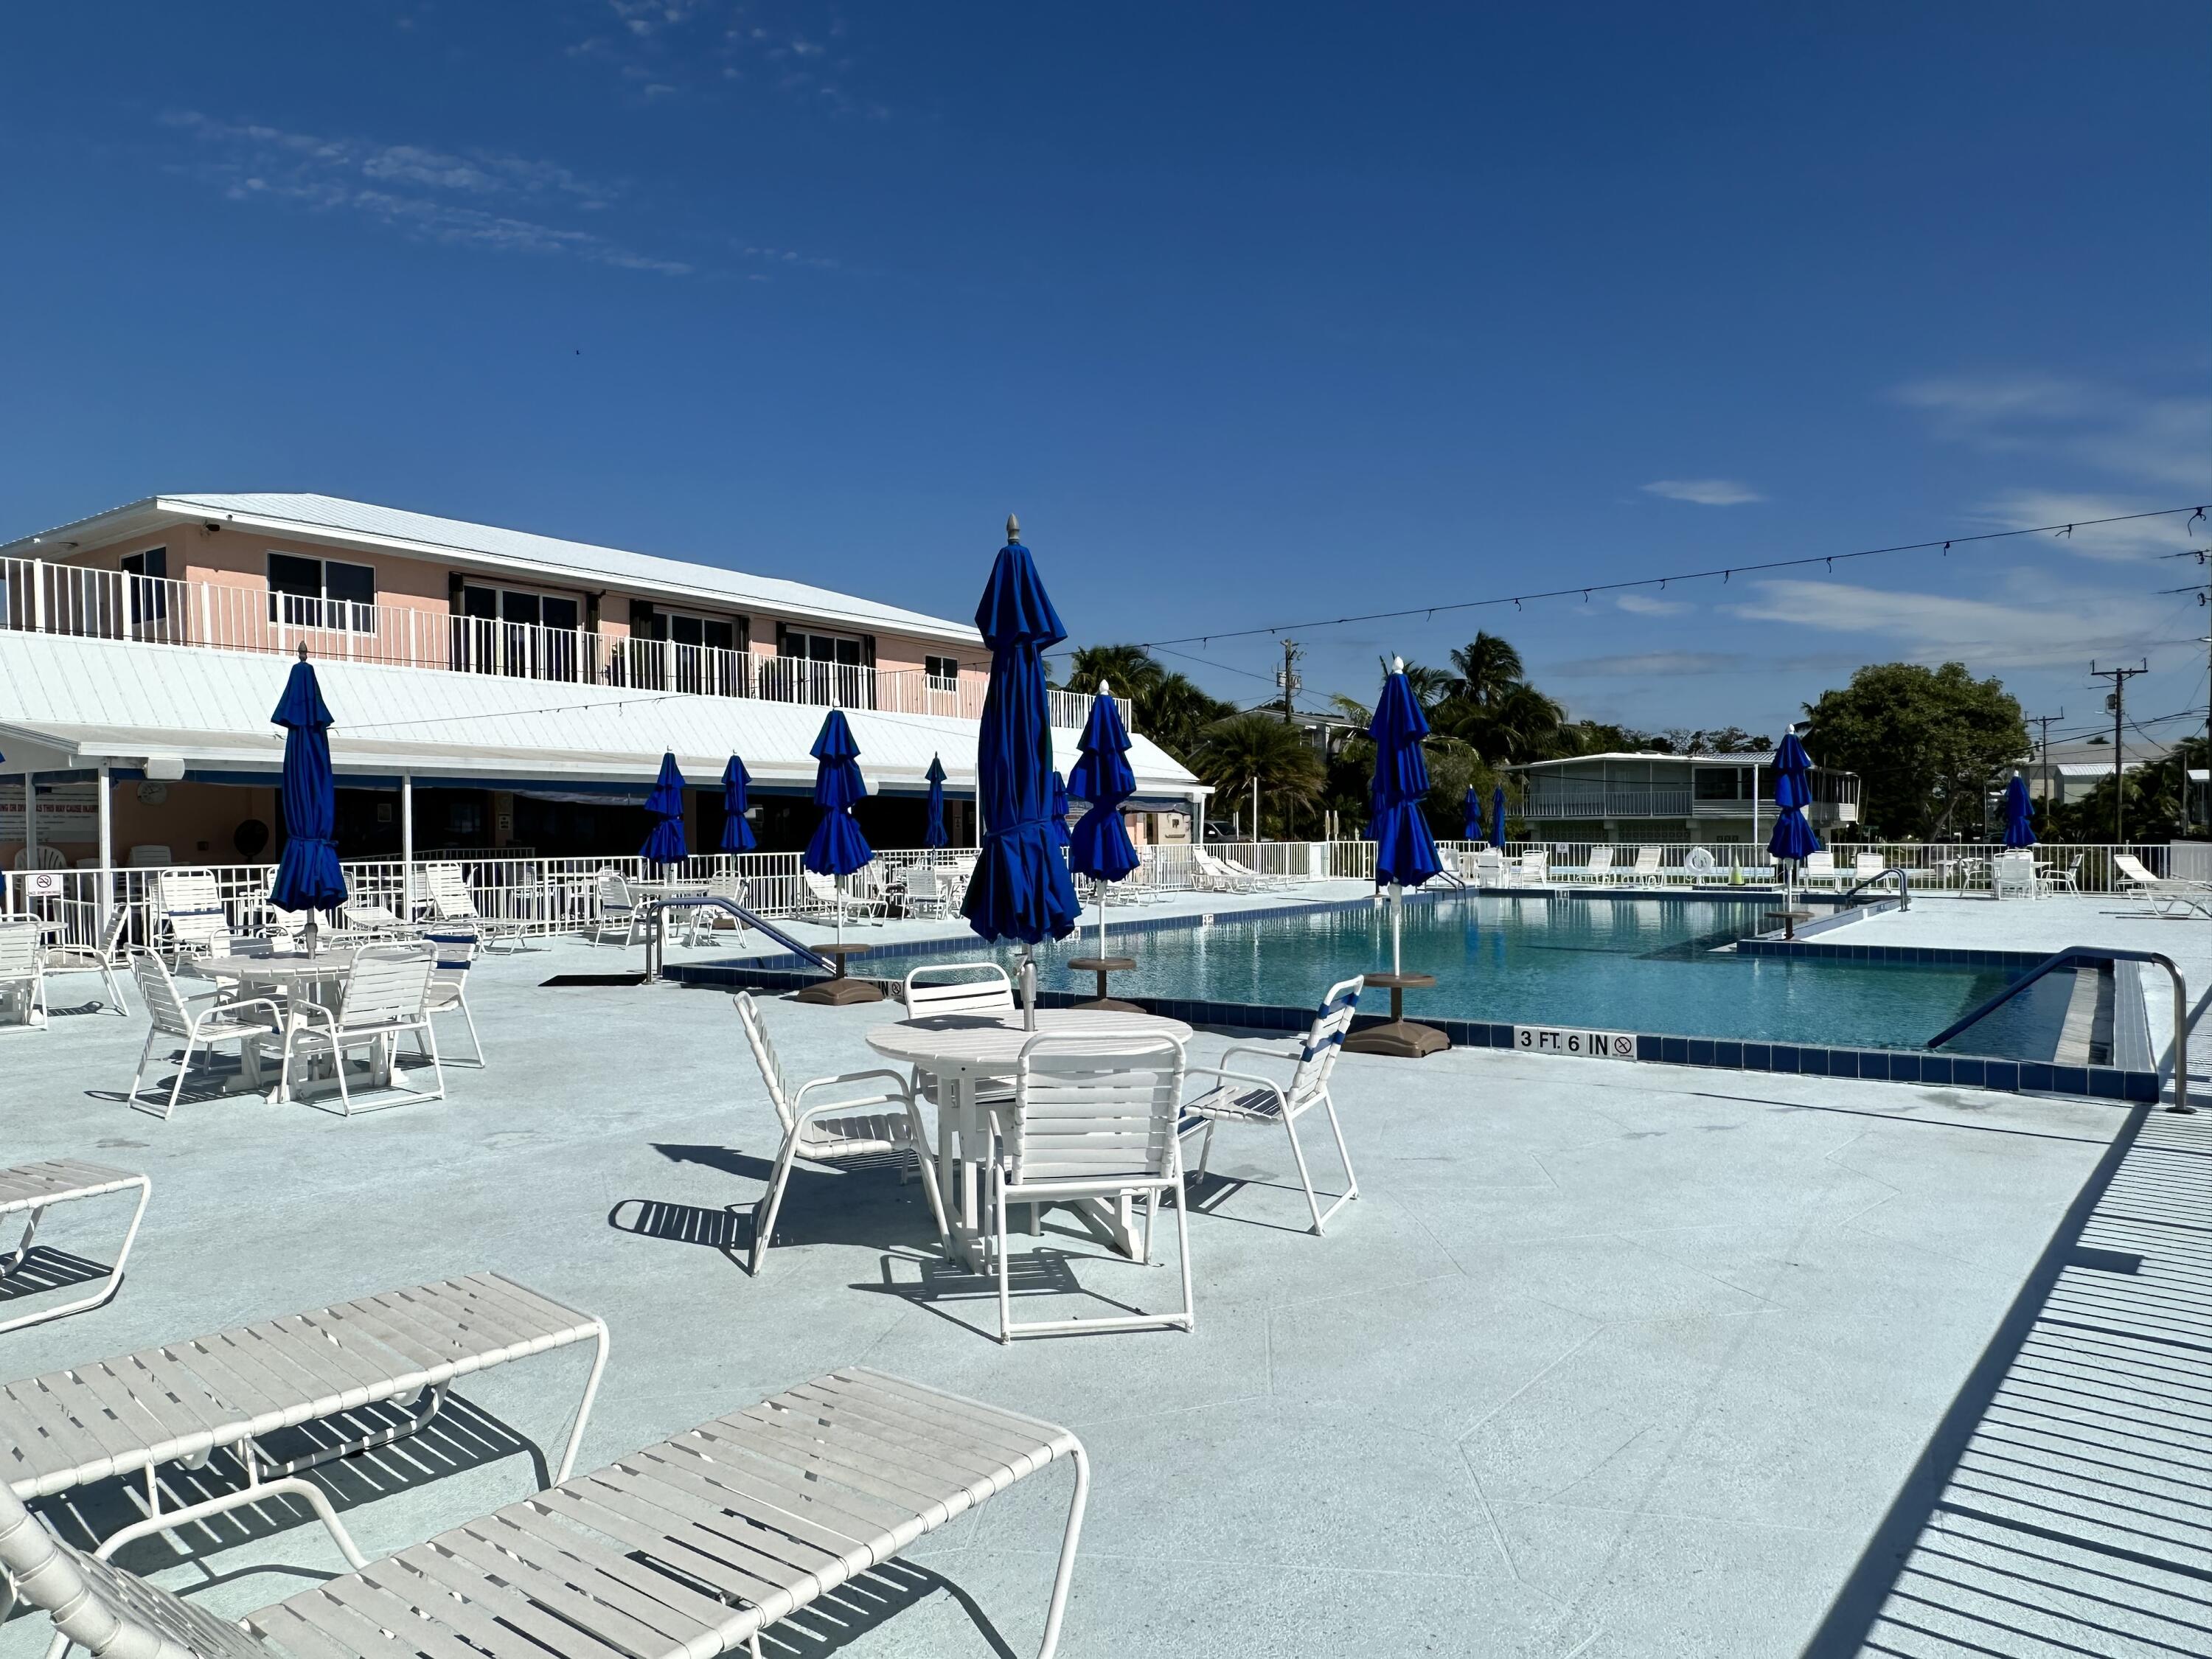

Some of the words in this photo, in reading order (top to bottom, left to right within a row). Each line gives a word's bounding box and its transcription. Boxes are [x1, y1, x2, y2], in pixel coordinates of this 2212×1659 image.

[1521, 1031, 1531, 1046] 3
[1540, 1032, 1560, 1049] FT.
[1568, 1035, 1579, 1051] 6
[1589, 1034, 1607, 1055] IN
